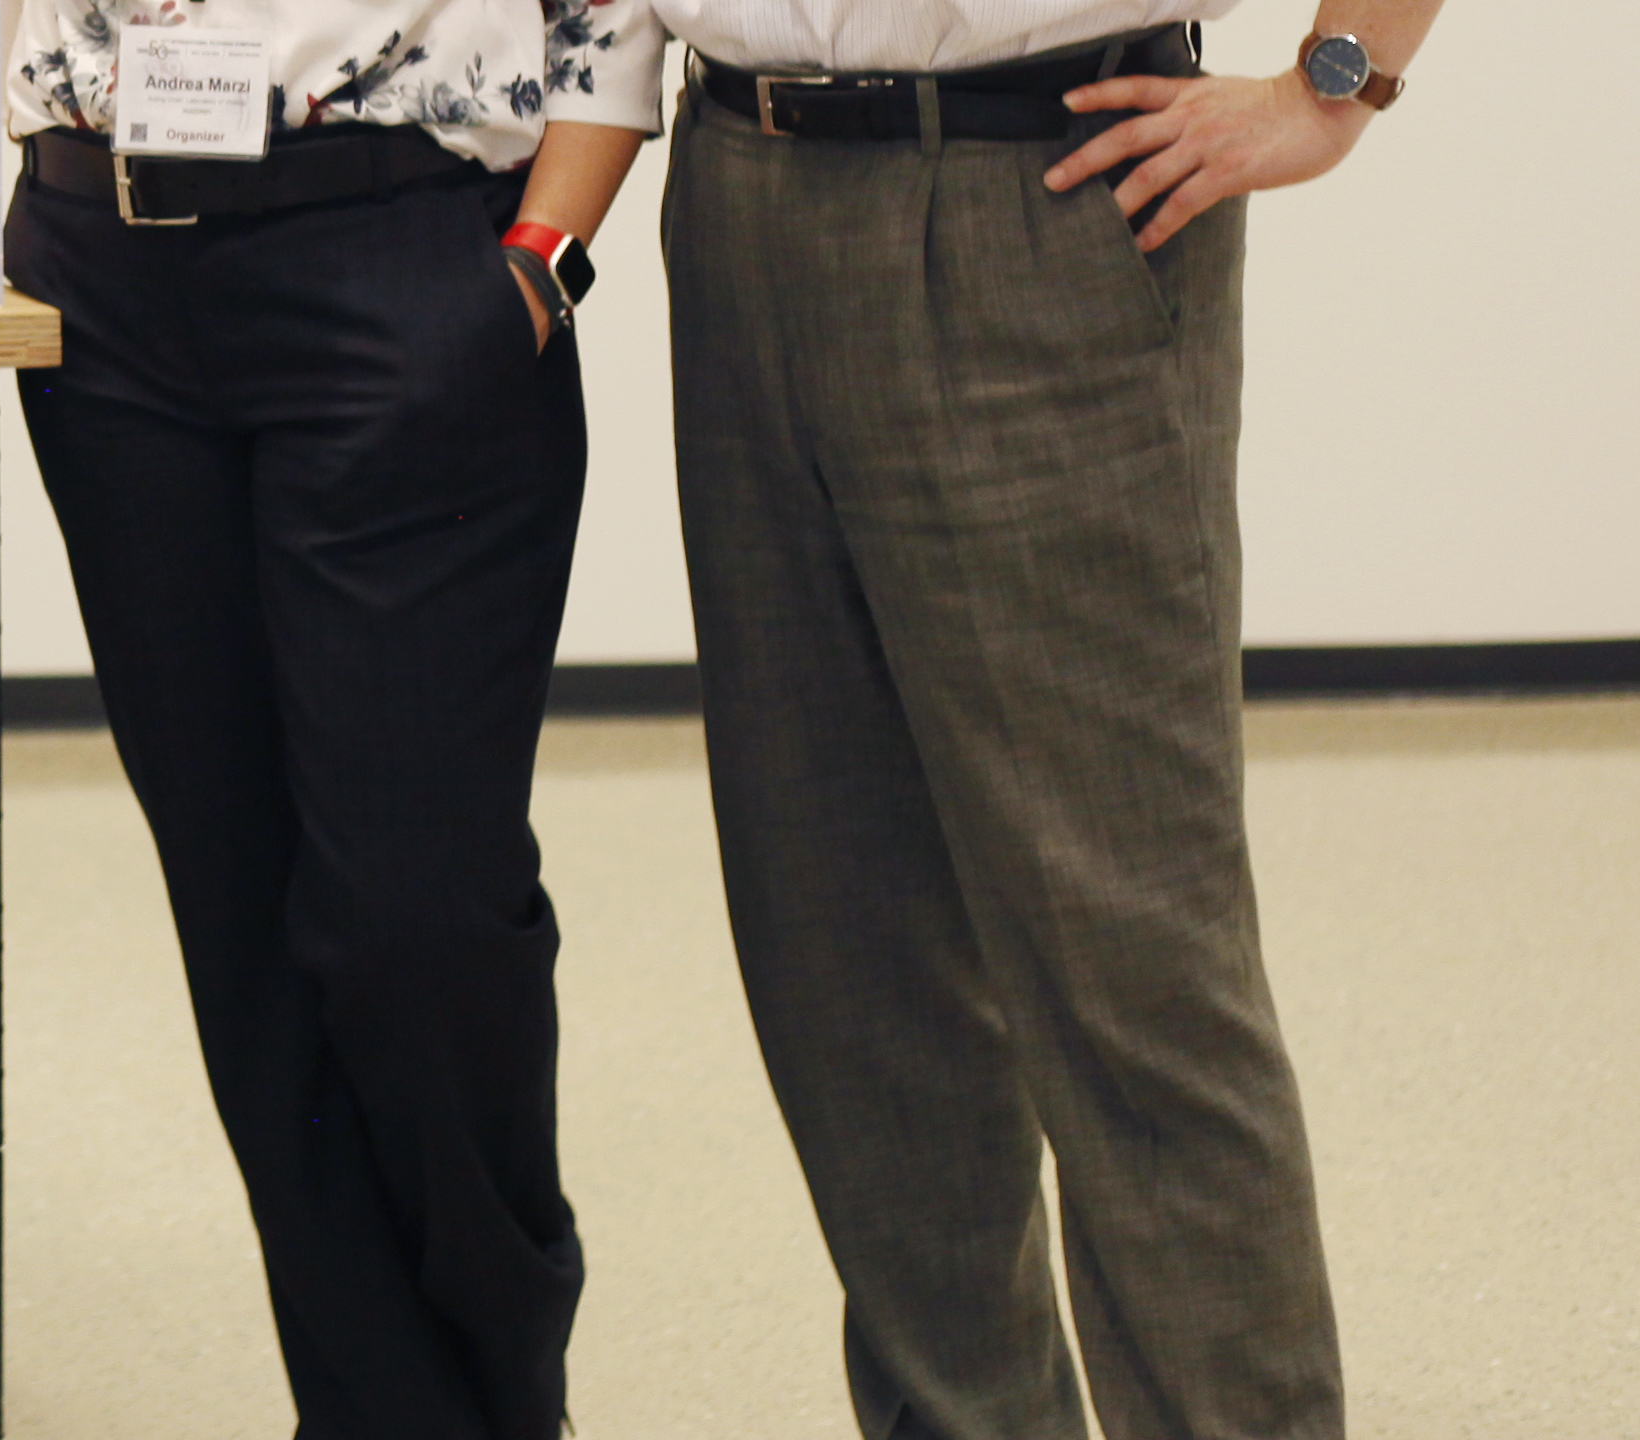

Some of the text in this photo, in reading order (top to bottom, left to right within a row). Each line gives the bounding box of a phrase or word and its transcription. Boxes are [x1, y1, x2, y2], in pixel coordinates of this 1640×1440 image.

[145, 75, 250, 93] Andrea Marzi
[166, 129, 225, 143] Organizer
